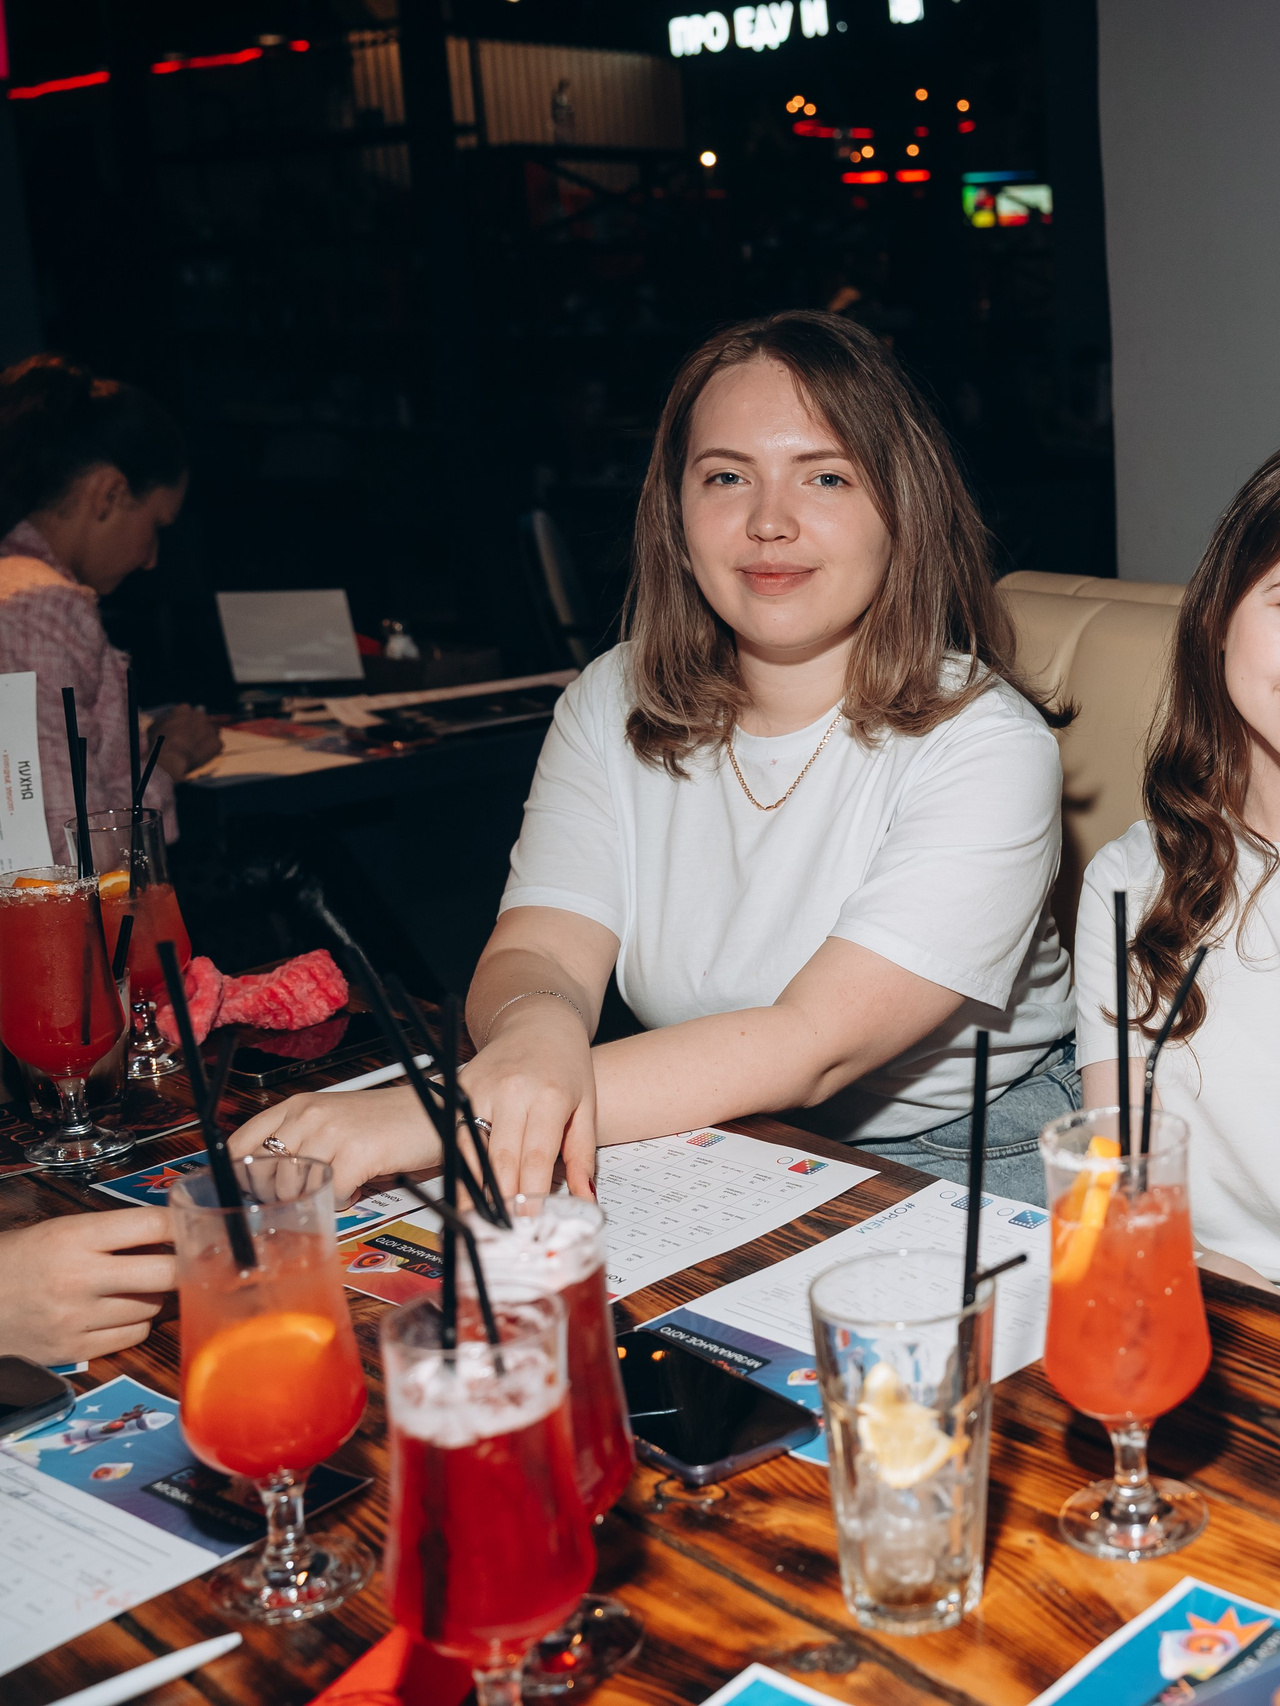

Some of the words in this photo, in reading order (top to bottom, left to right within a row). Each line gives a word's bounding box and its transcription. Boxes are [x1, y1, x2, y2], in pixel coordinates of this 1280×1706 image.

[669, 11, 729, 57] ПРО
[734, 1, 794, 52] ЕДУ
[17, 760, 34, 800] КУХНЯ
[375, 1237, 400, 1247] ЛОТО
[407, 1260, 443, 1278] ВАУ
[660, 1325, 690, 1341] ЛОТО
[685, 1335, 763, 1369] МУЗЫКАЛЬНОЕ
